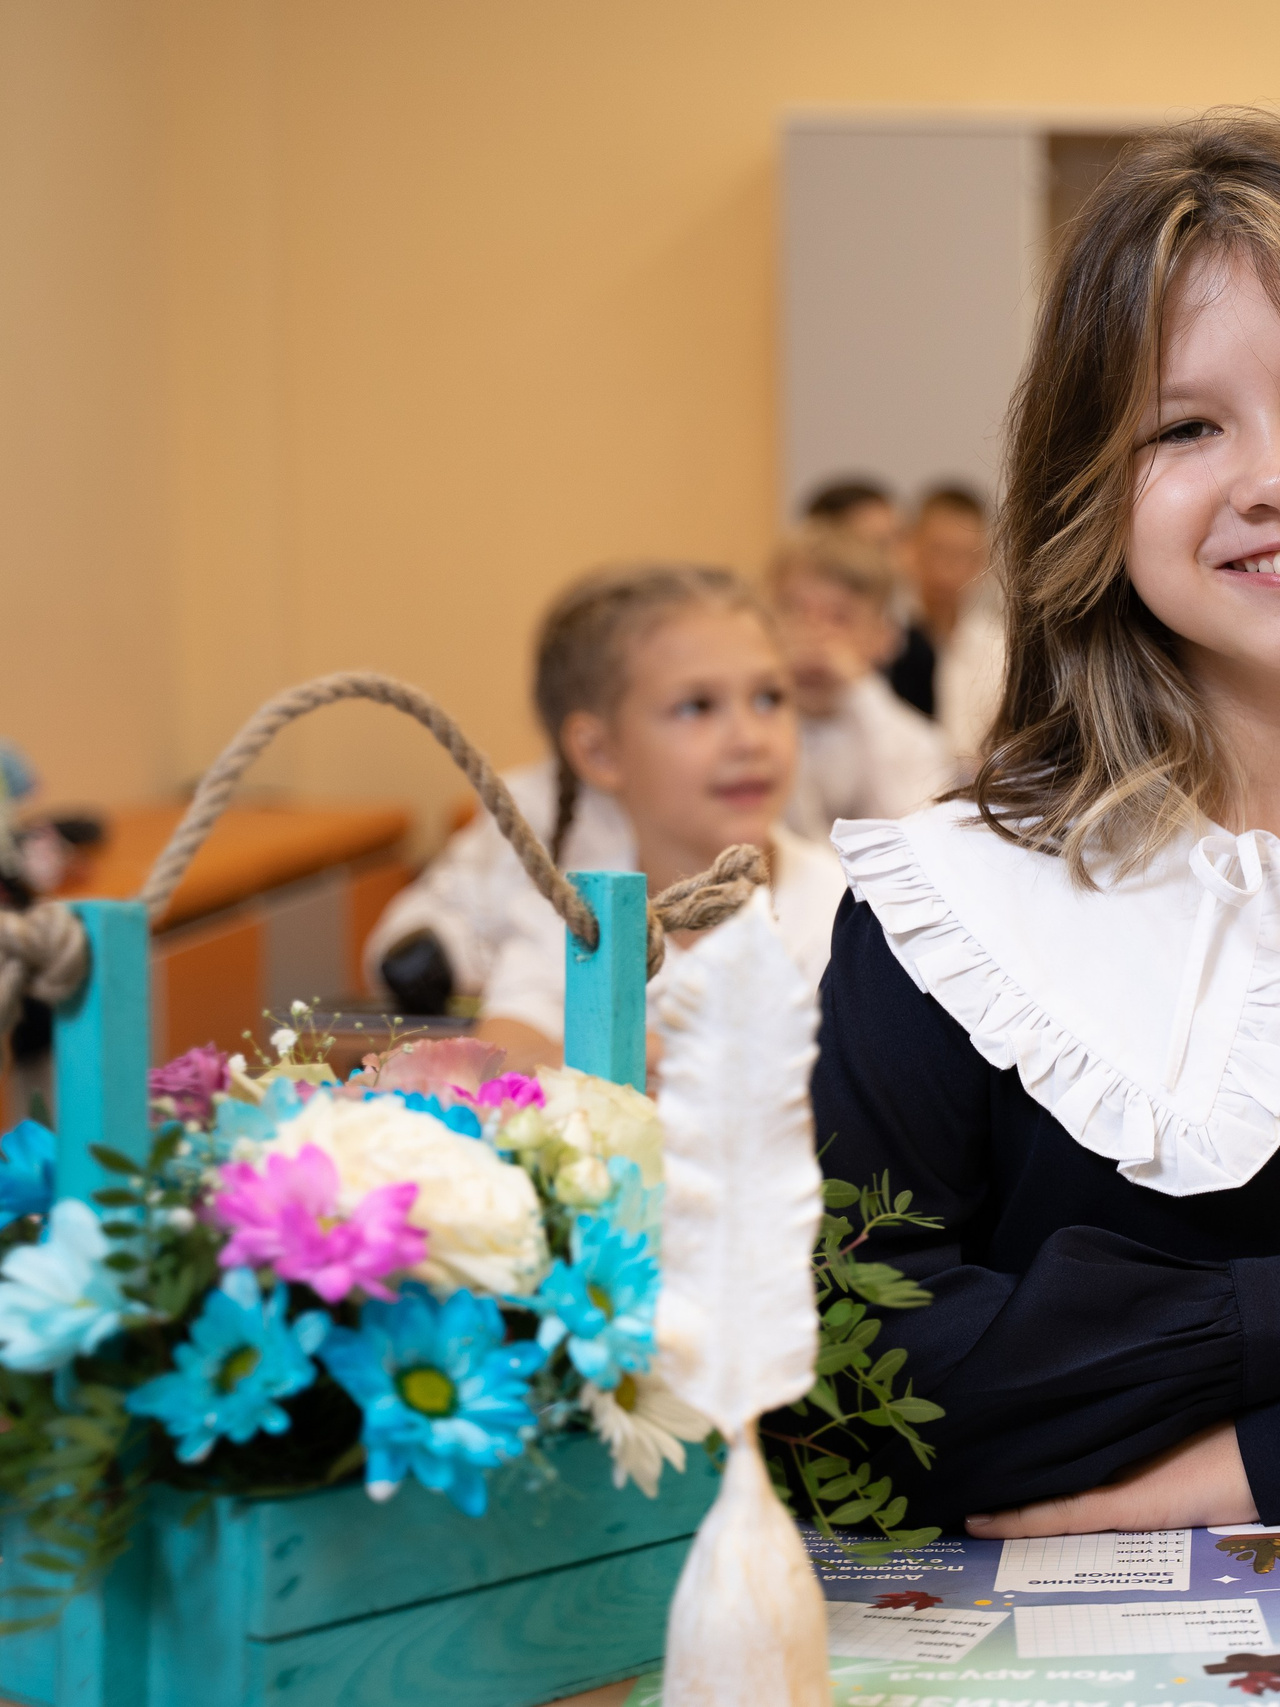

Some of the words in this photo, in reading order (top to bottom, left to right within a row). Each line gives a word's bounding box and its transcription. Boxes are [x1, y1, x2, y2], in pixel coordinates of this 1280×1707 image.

[863, 1614, 947, 1624] рождения
[907, 1628, 977, 1638] Телефон
[914, 1640, 966, 1649] Адрес
[888, 1668, 1036, 1682] друзья
[1046, 1669, 1136, 1682] Мои
